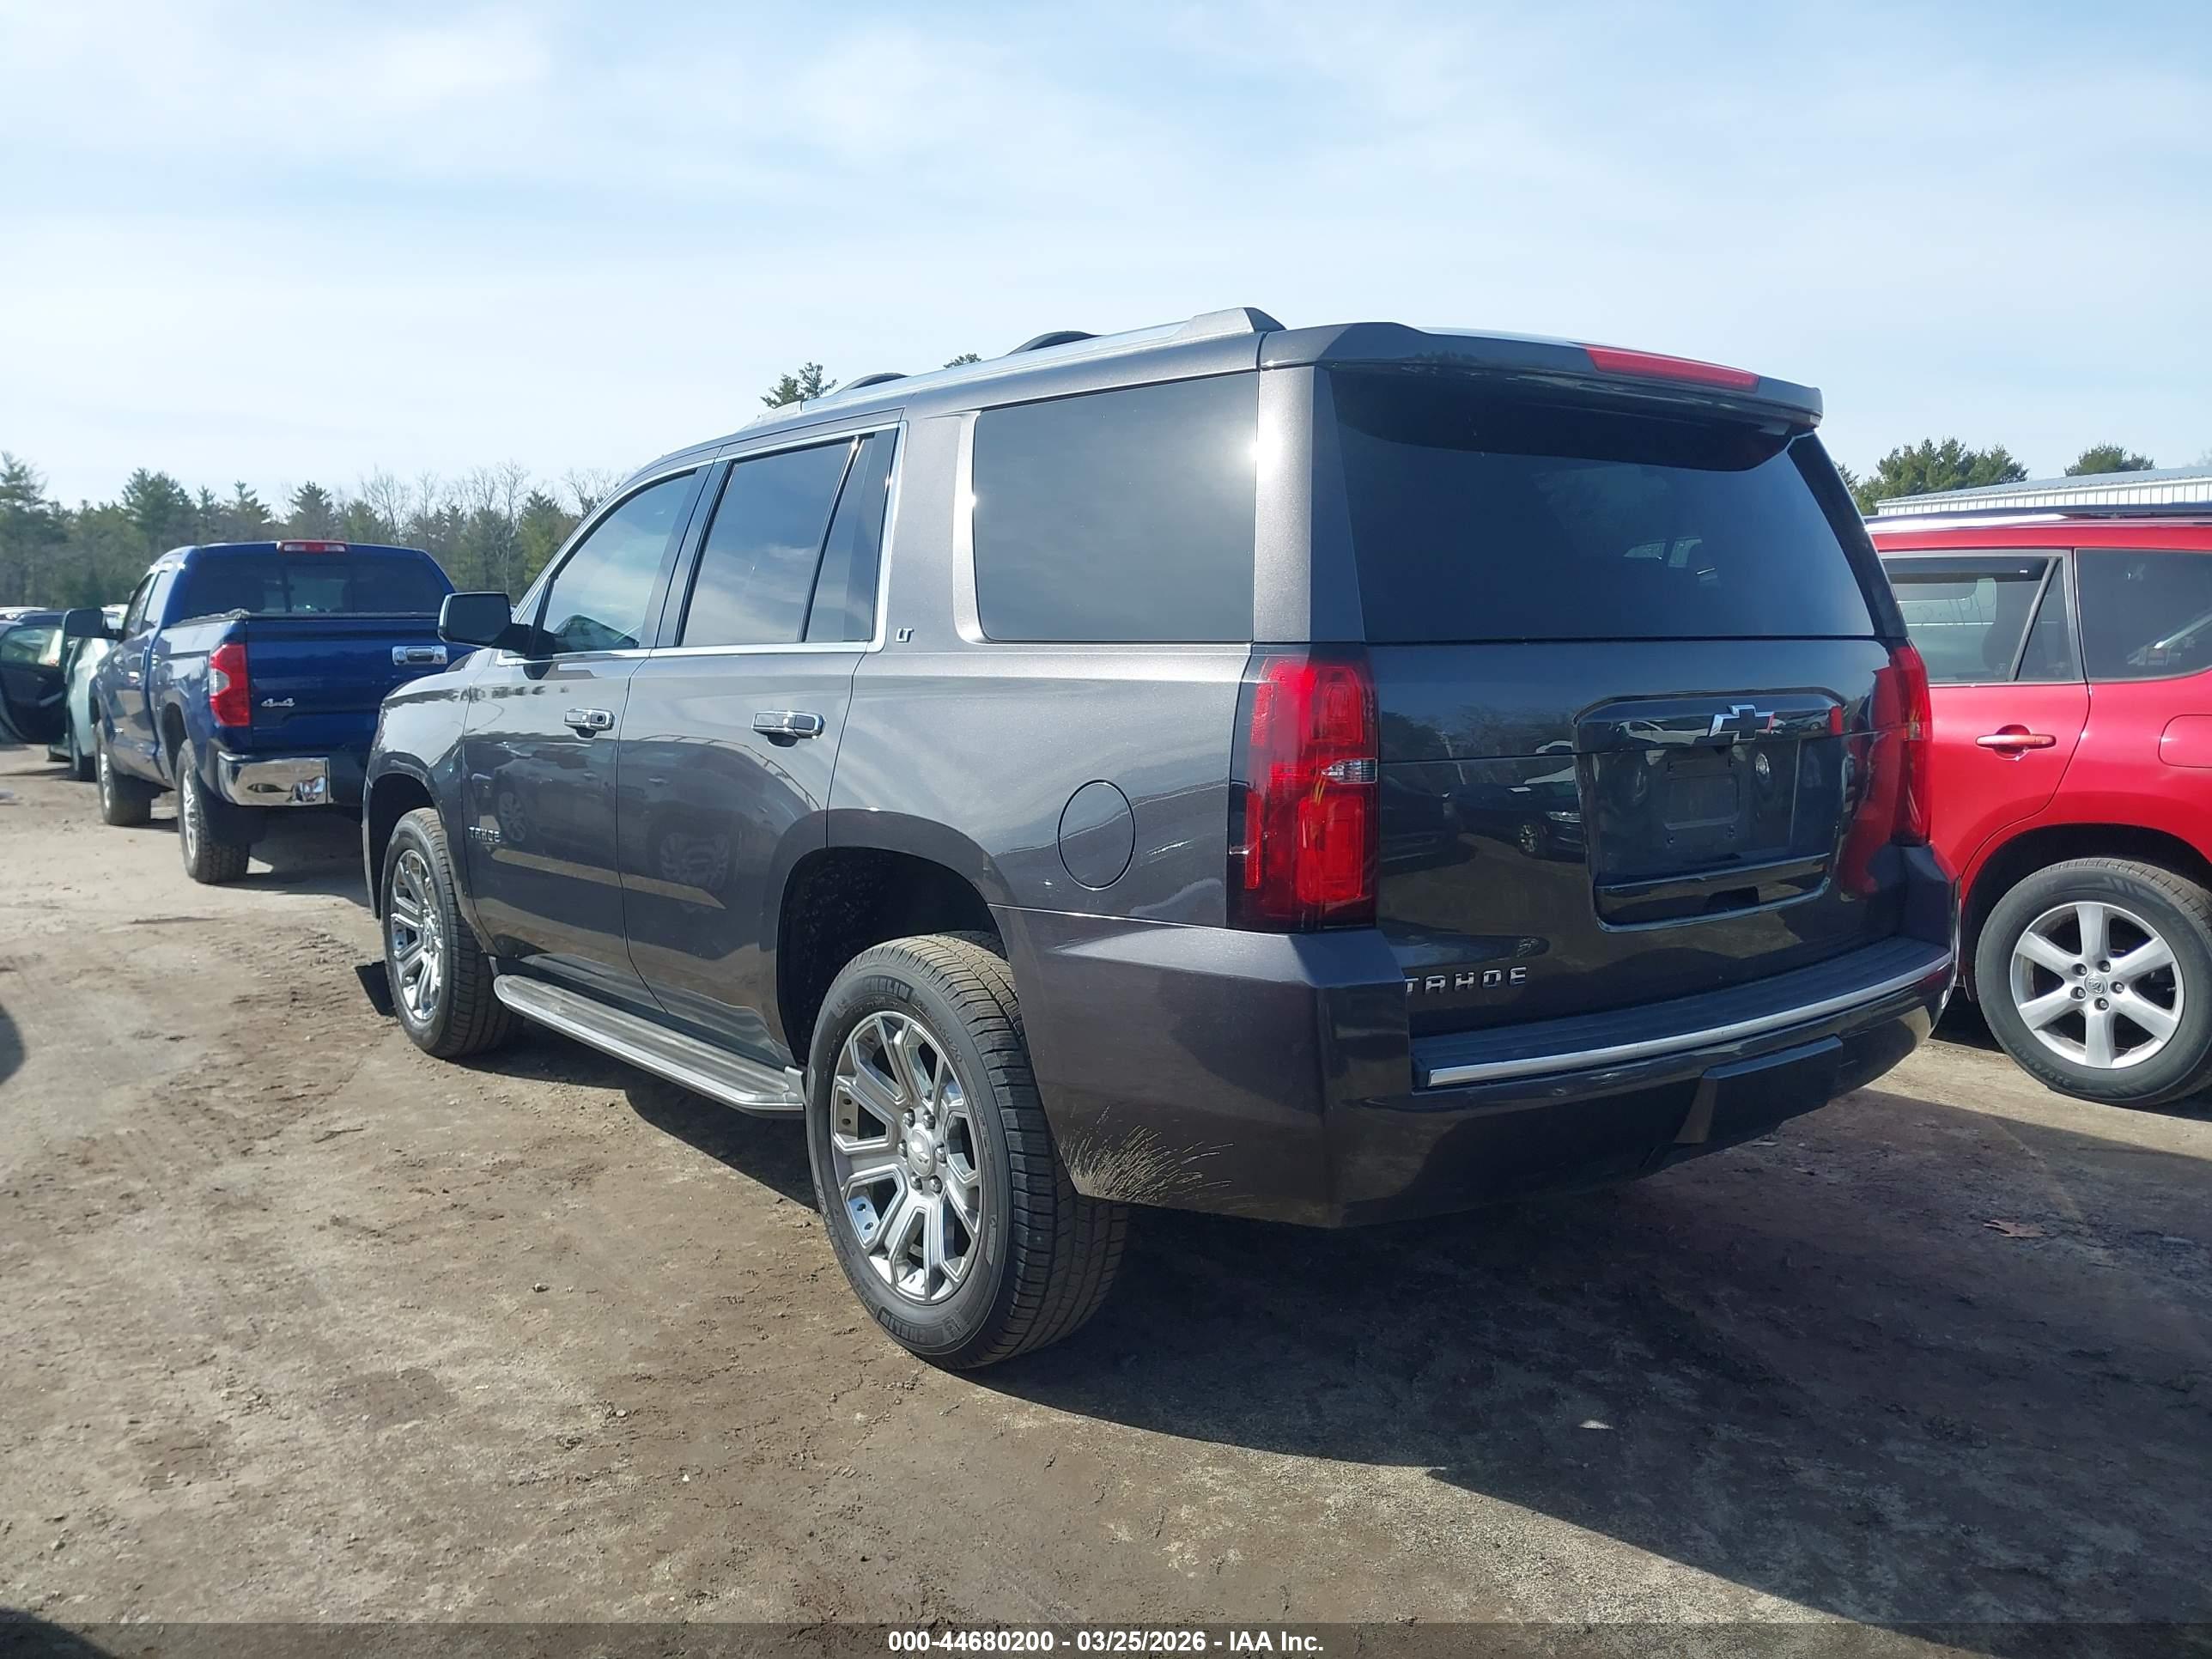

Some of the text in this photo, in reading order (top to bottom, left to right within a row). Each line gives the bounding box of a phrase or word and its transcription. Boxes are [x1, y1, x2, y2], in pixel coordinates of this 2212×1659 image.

[896, 628, 914, 643] LT
[469, 826, 501, 843] TAHOE
[1404, 967, 1528, 996] TAHOE
